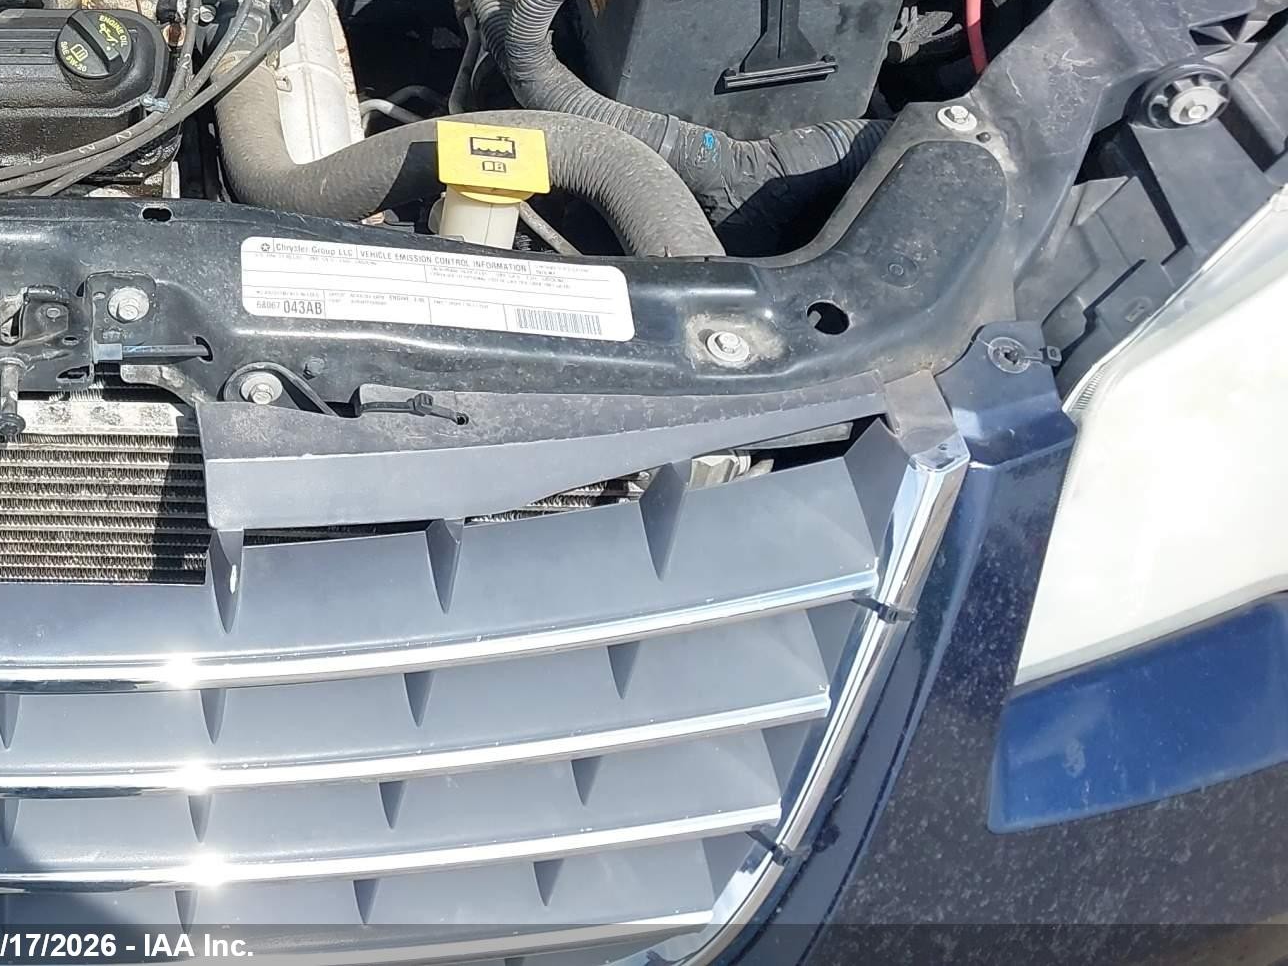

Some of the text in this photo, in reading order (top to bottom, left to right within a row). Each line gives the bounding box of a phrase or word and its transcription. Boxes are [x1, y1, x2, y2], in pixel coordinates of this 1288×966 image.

[99, 15, 128, 47] ENGINE OIL
[65, 55, 87, 72] 5W-20
[311, 245, 336, 256] Group
[338, 248, 353, 257] LLC
[360, 250, 392, 260] VEHICLE
[395, 253, 432, 264] EMISSION
[434, 256, 470, 267] CONTROL
[473, 261, 527, 273] INFORMATION
[283, 300, 323, 315] 043AB
